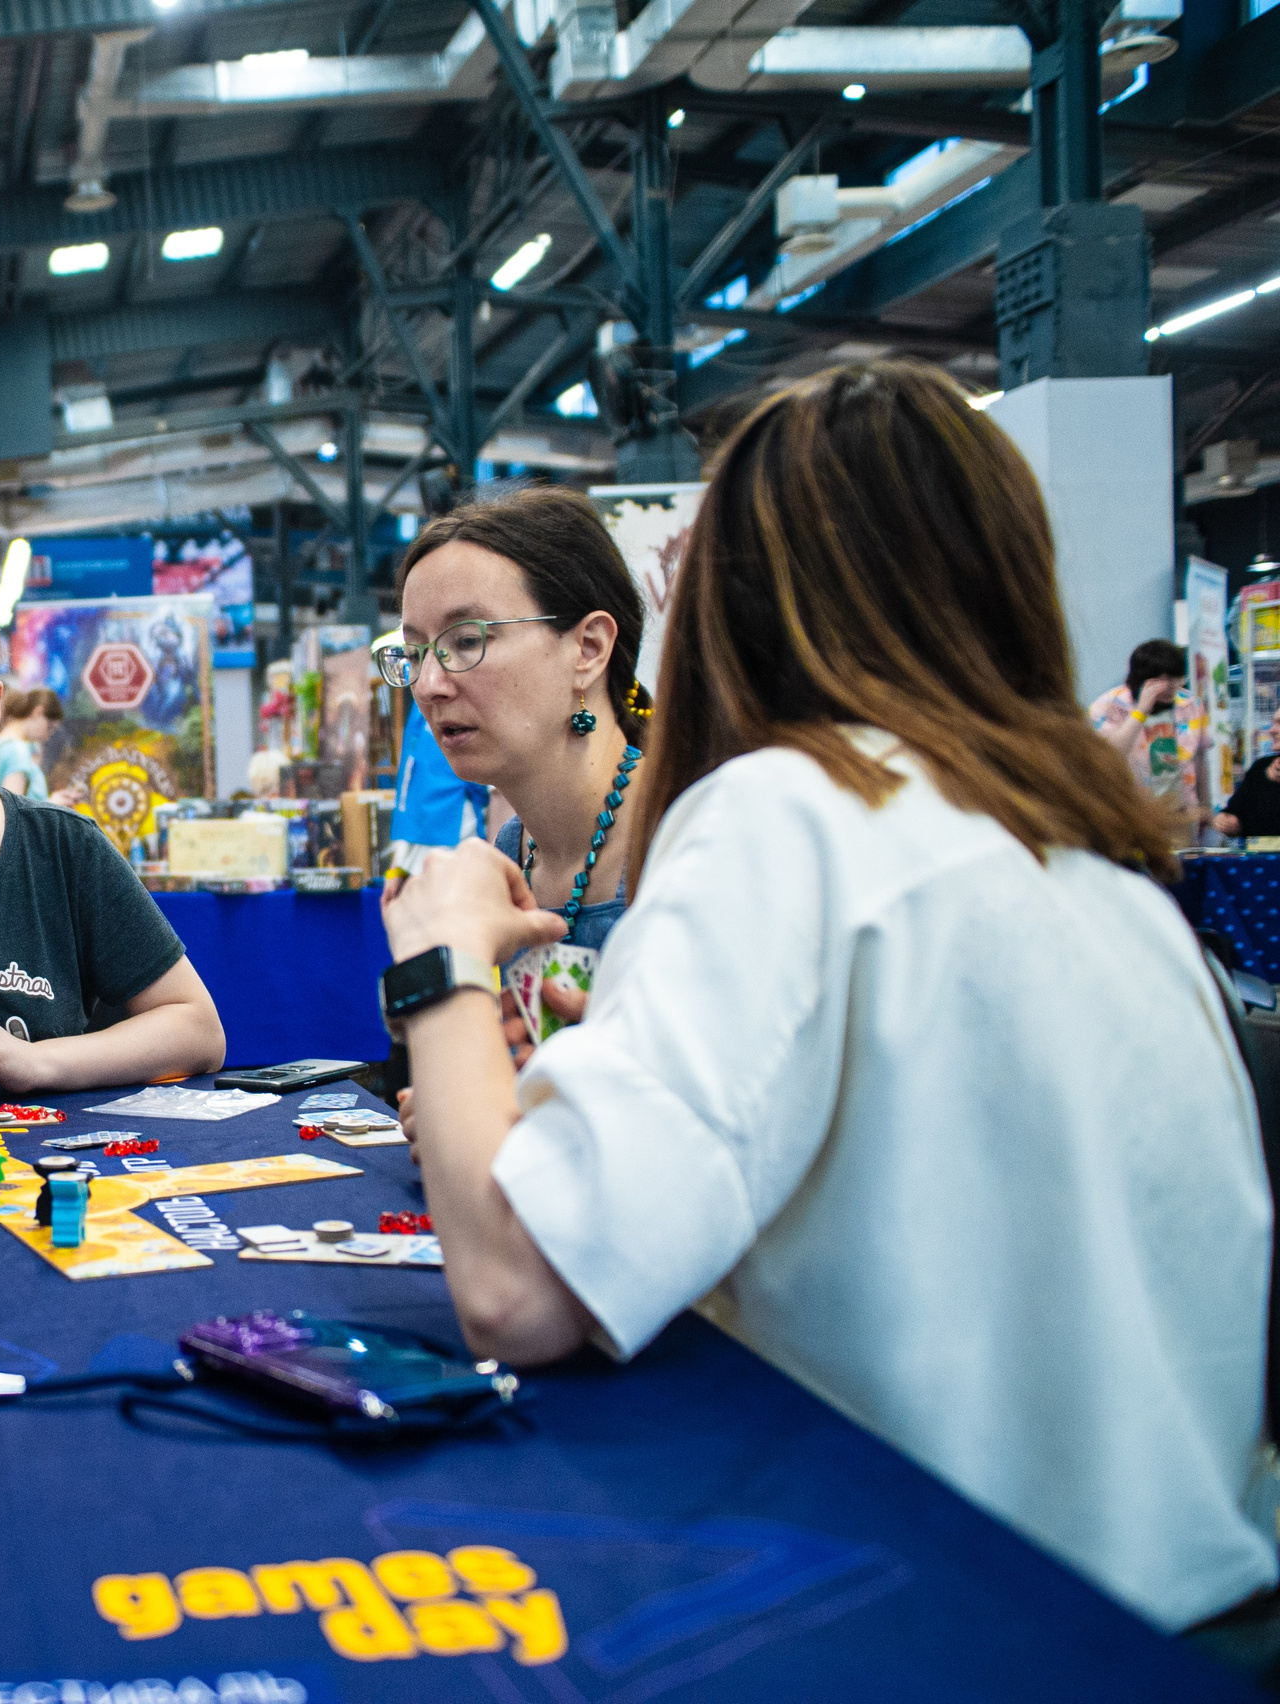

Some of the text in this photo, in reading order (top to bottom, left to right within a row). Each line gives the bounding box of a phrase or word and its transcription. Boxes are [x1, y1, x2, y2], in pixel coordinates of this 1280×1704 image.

[155, 1196, 242, 1250] НАСТОЛЬ
[92, 1545, 536, 1640] games
[320, 1587, 568, 1666] day
